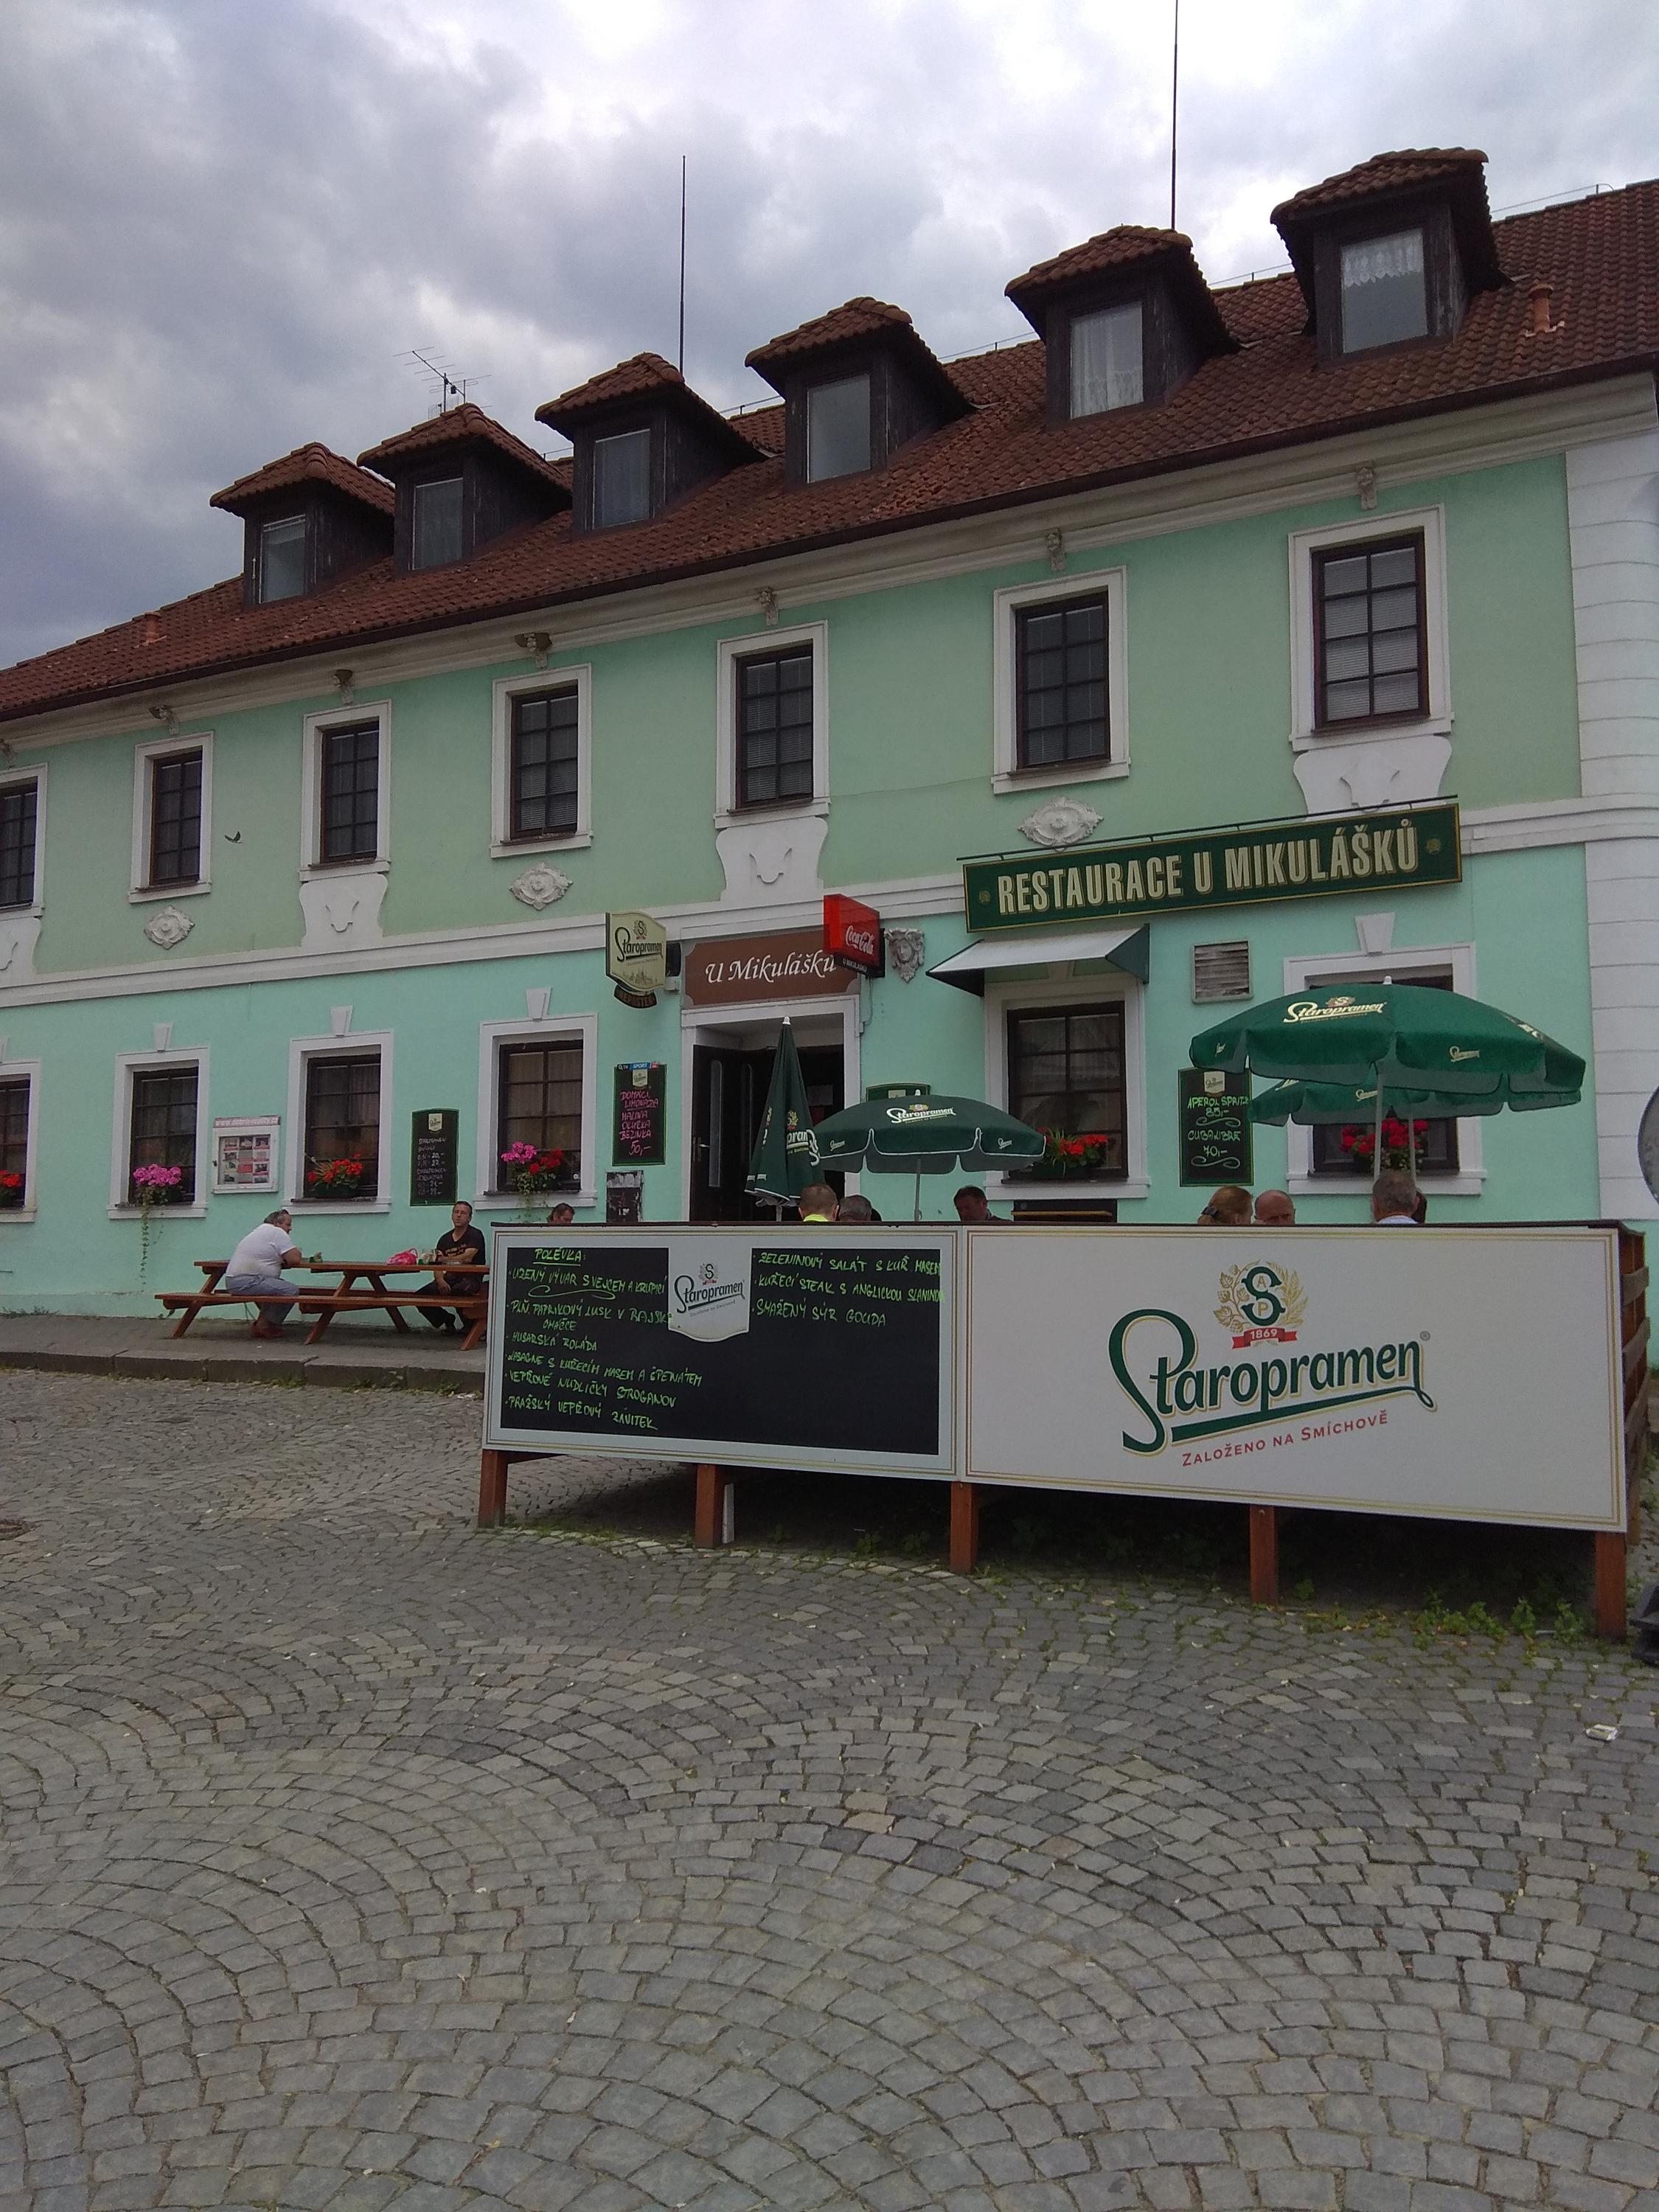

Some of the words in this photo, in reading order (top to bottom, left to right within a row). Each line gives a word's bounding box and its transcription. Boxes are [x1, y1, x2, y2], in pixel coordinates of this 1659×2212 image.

[998, 854, 1183, 916] RESTAURACE
[1192, 851, 1214, 893] U
[1223, 818, 1419, 891] MIKULÁŠKŮ
[614, 926, 664, 962] Staropramen
[704, 961, 726, 984] U
[1283, 1001, 1384, 1023] Staropramen
[1187, 1096, 1220, 1109] APEROL
[886, 1107, 956, 1124] Staropramen
[829, 1255, 867, 1273] SALÁT
[875, 1259, 883, 1272] S
[582, 1275, 590, 1287] S
[627, 1280, 633, 1291] A
[674, 1275, 745, 1313] Staropramen
[799, 1278, 835, 1295] STEAK
[839, 1282, 846, 1295] S
[852, 1283, 902, 1302] ANGLICKOU
[617, 1309, 625, 1320] V
[812, 1301, 838, 1321] SÝR
[846, 1308, 887, 1327] GOUDA
[1250, 1328, 1278, 1340] 1869
[548, 1357, 555, 1368] S
[637, 1369, 645, 1382] A
[1108, 1308, 1435, 1453] Staropramen
[1273, 1433, 1295, 1447] NA
